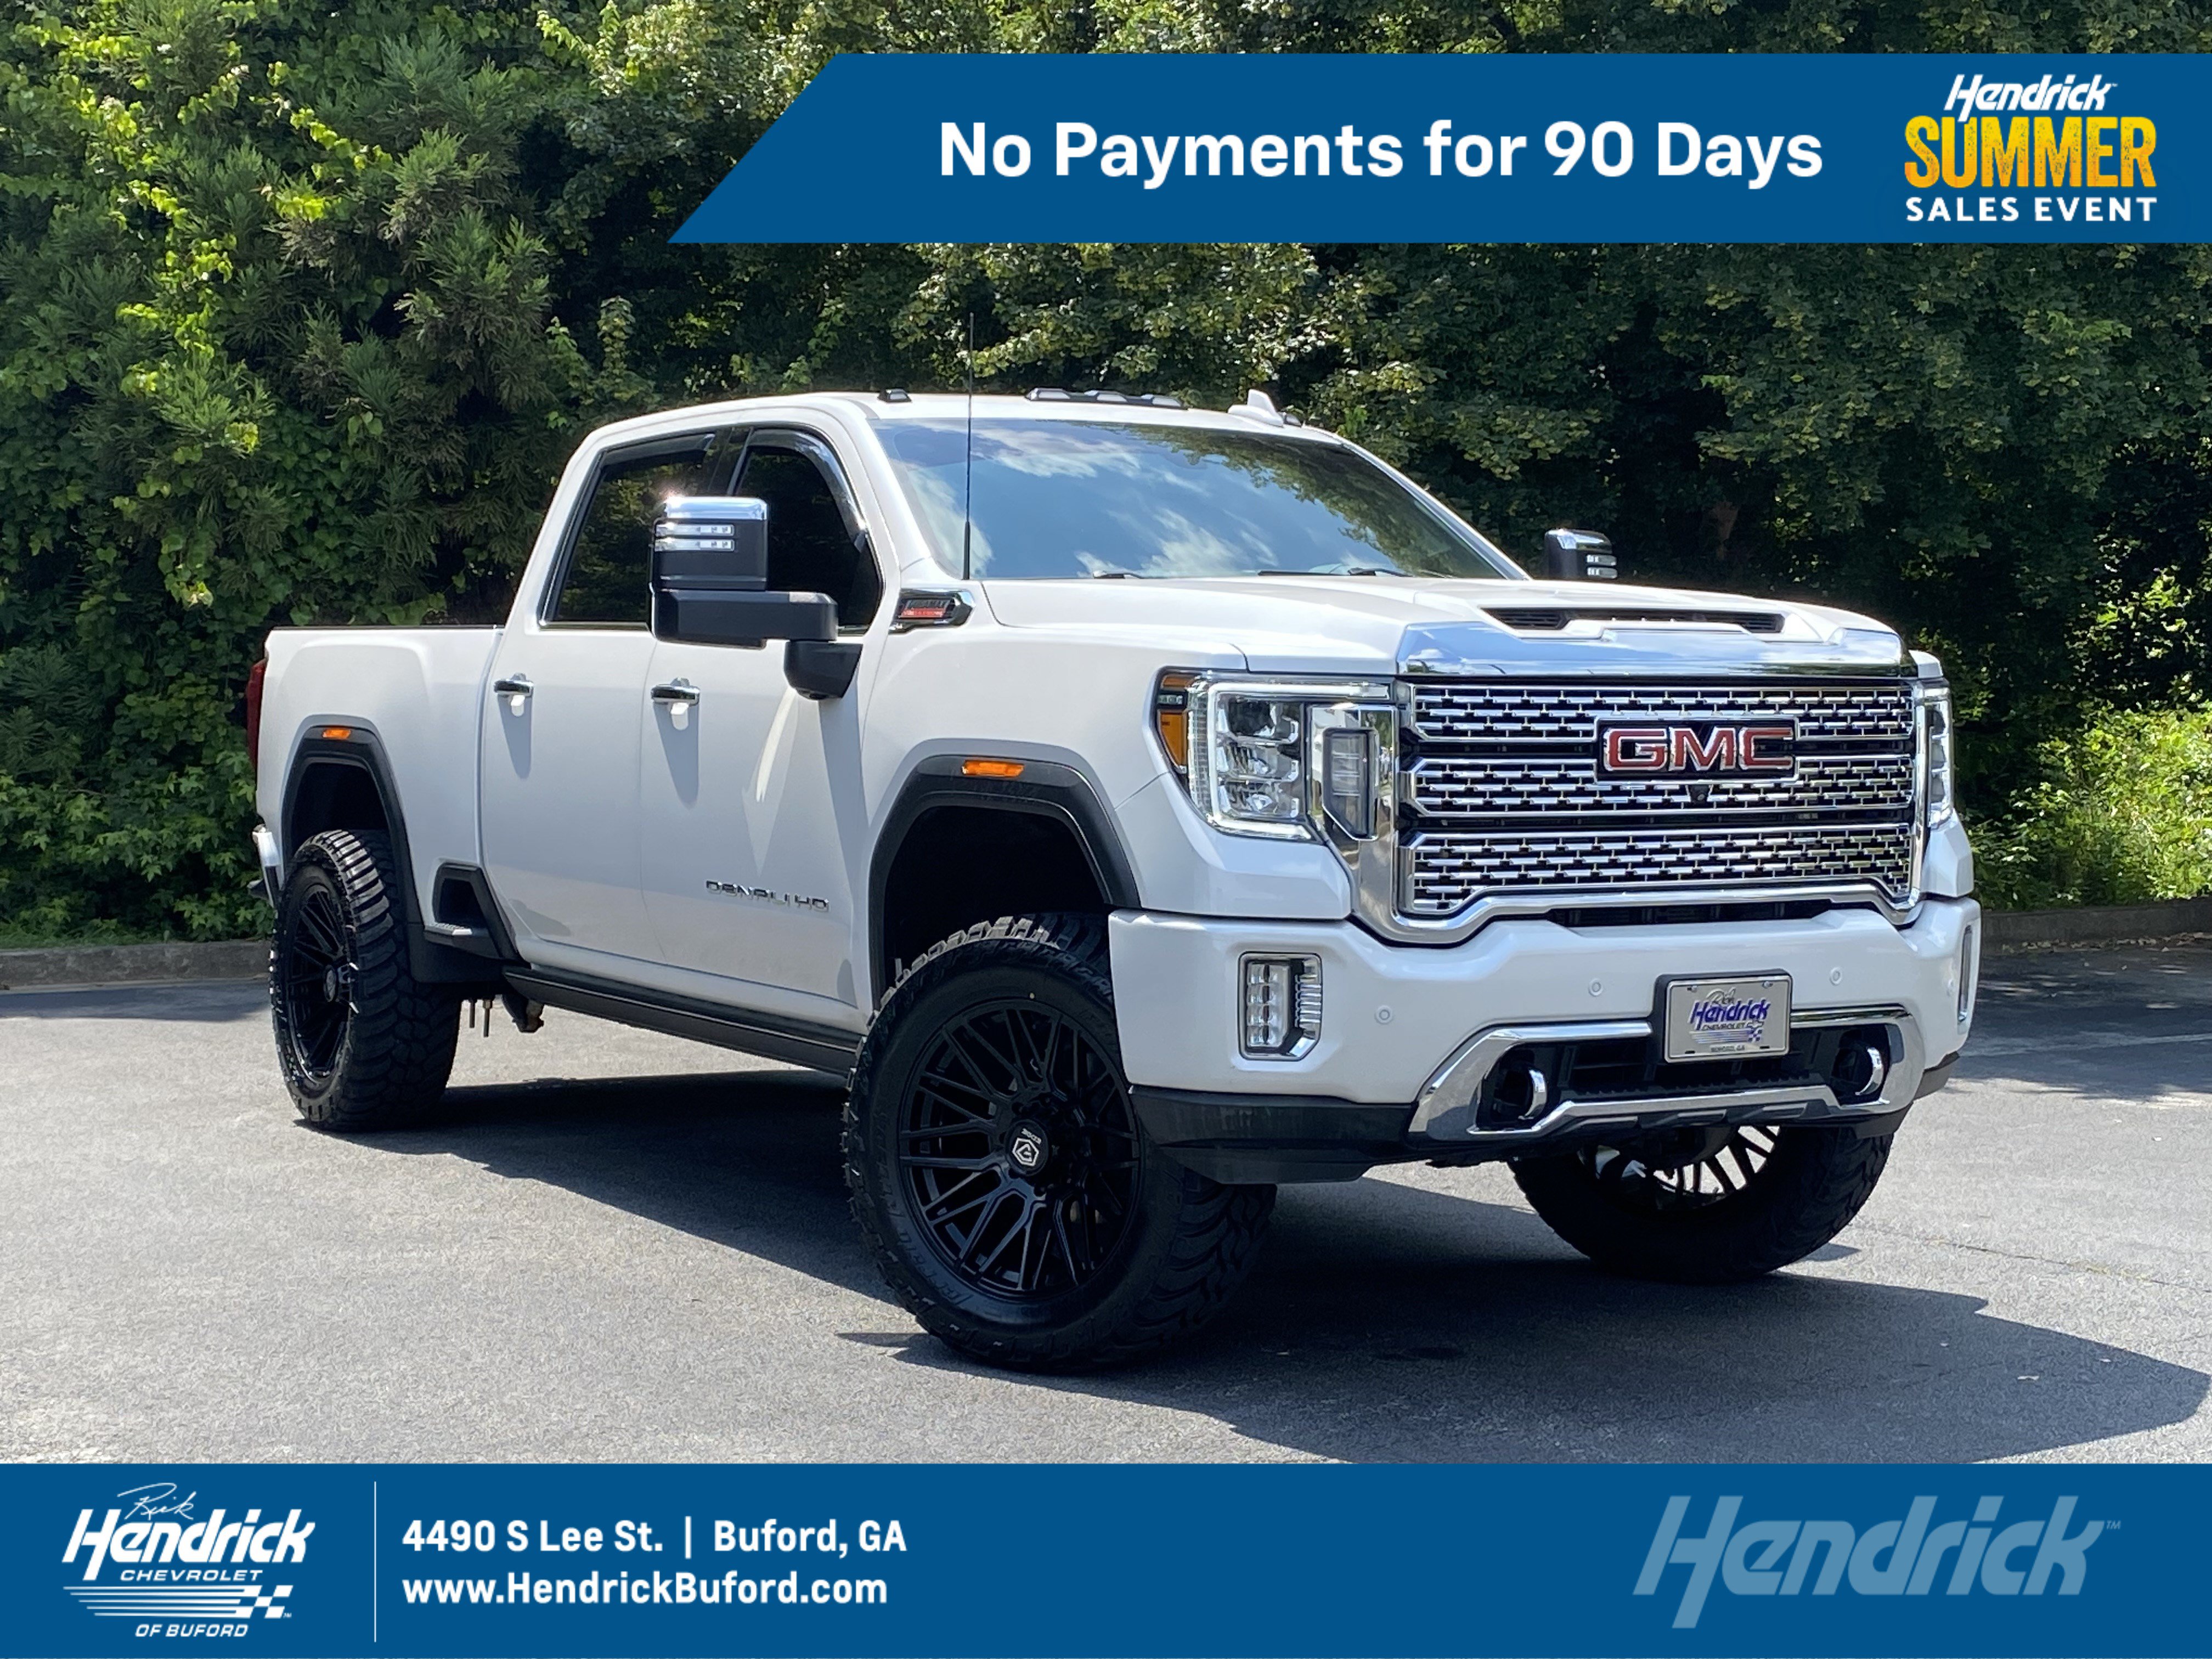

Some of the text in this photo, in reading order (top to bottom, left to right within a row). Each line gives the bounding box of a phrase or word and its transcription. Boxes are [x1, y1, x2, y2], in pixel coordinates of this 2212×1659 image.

[1603, 727, 1795, 771] GMC
[706, 880, 830, 912] DENALI HD
[1688, 997, 1771, 1031] Hendrick
